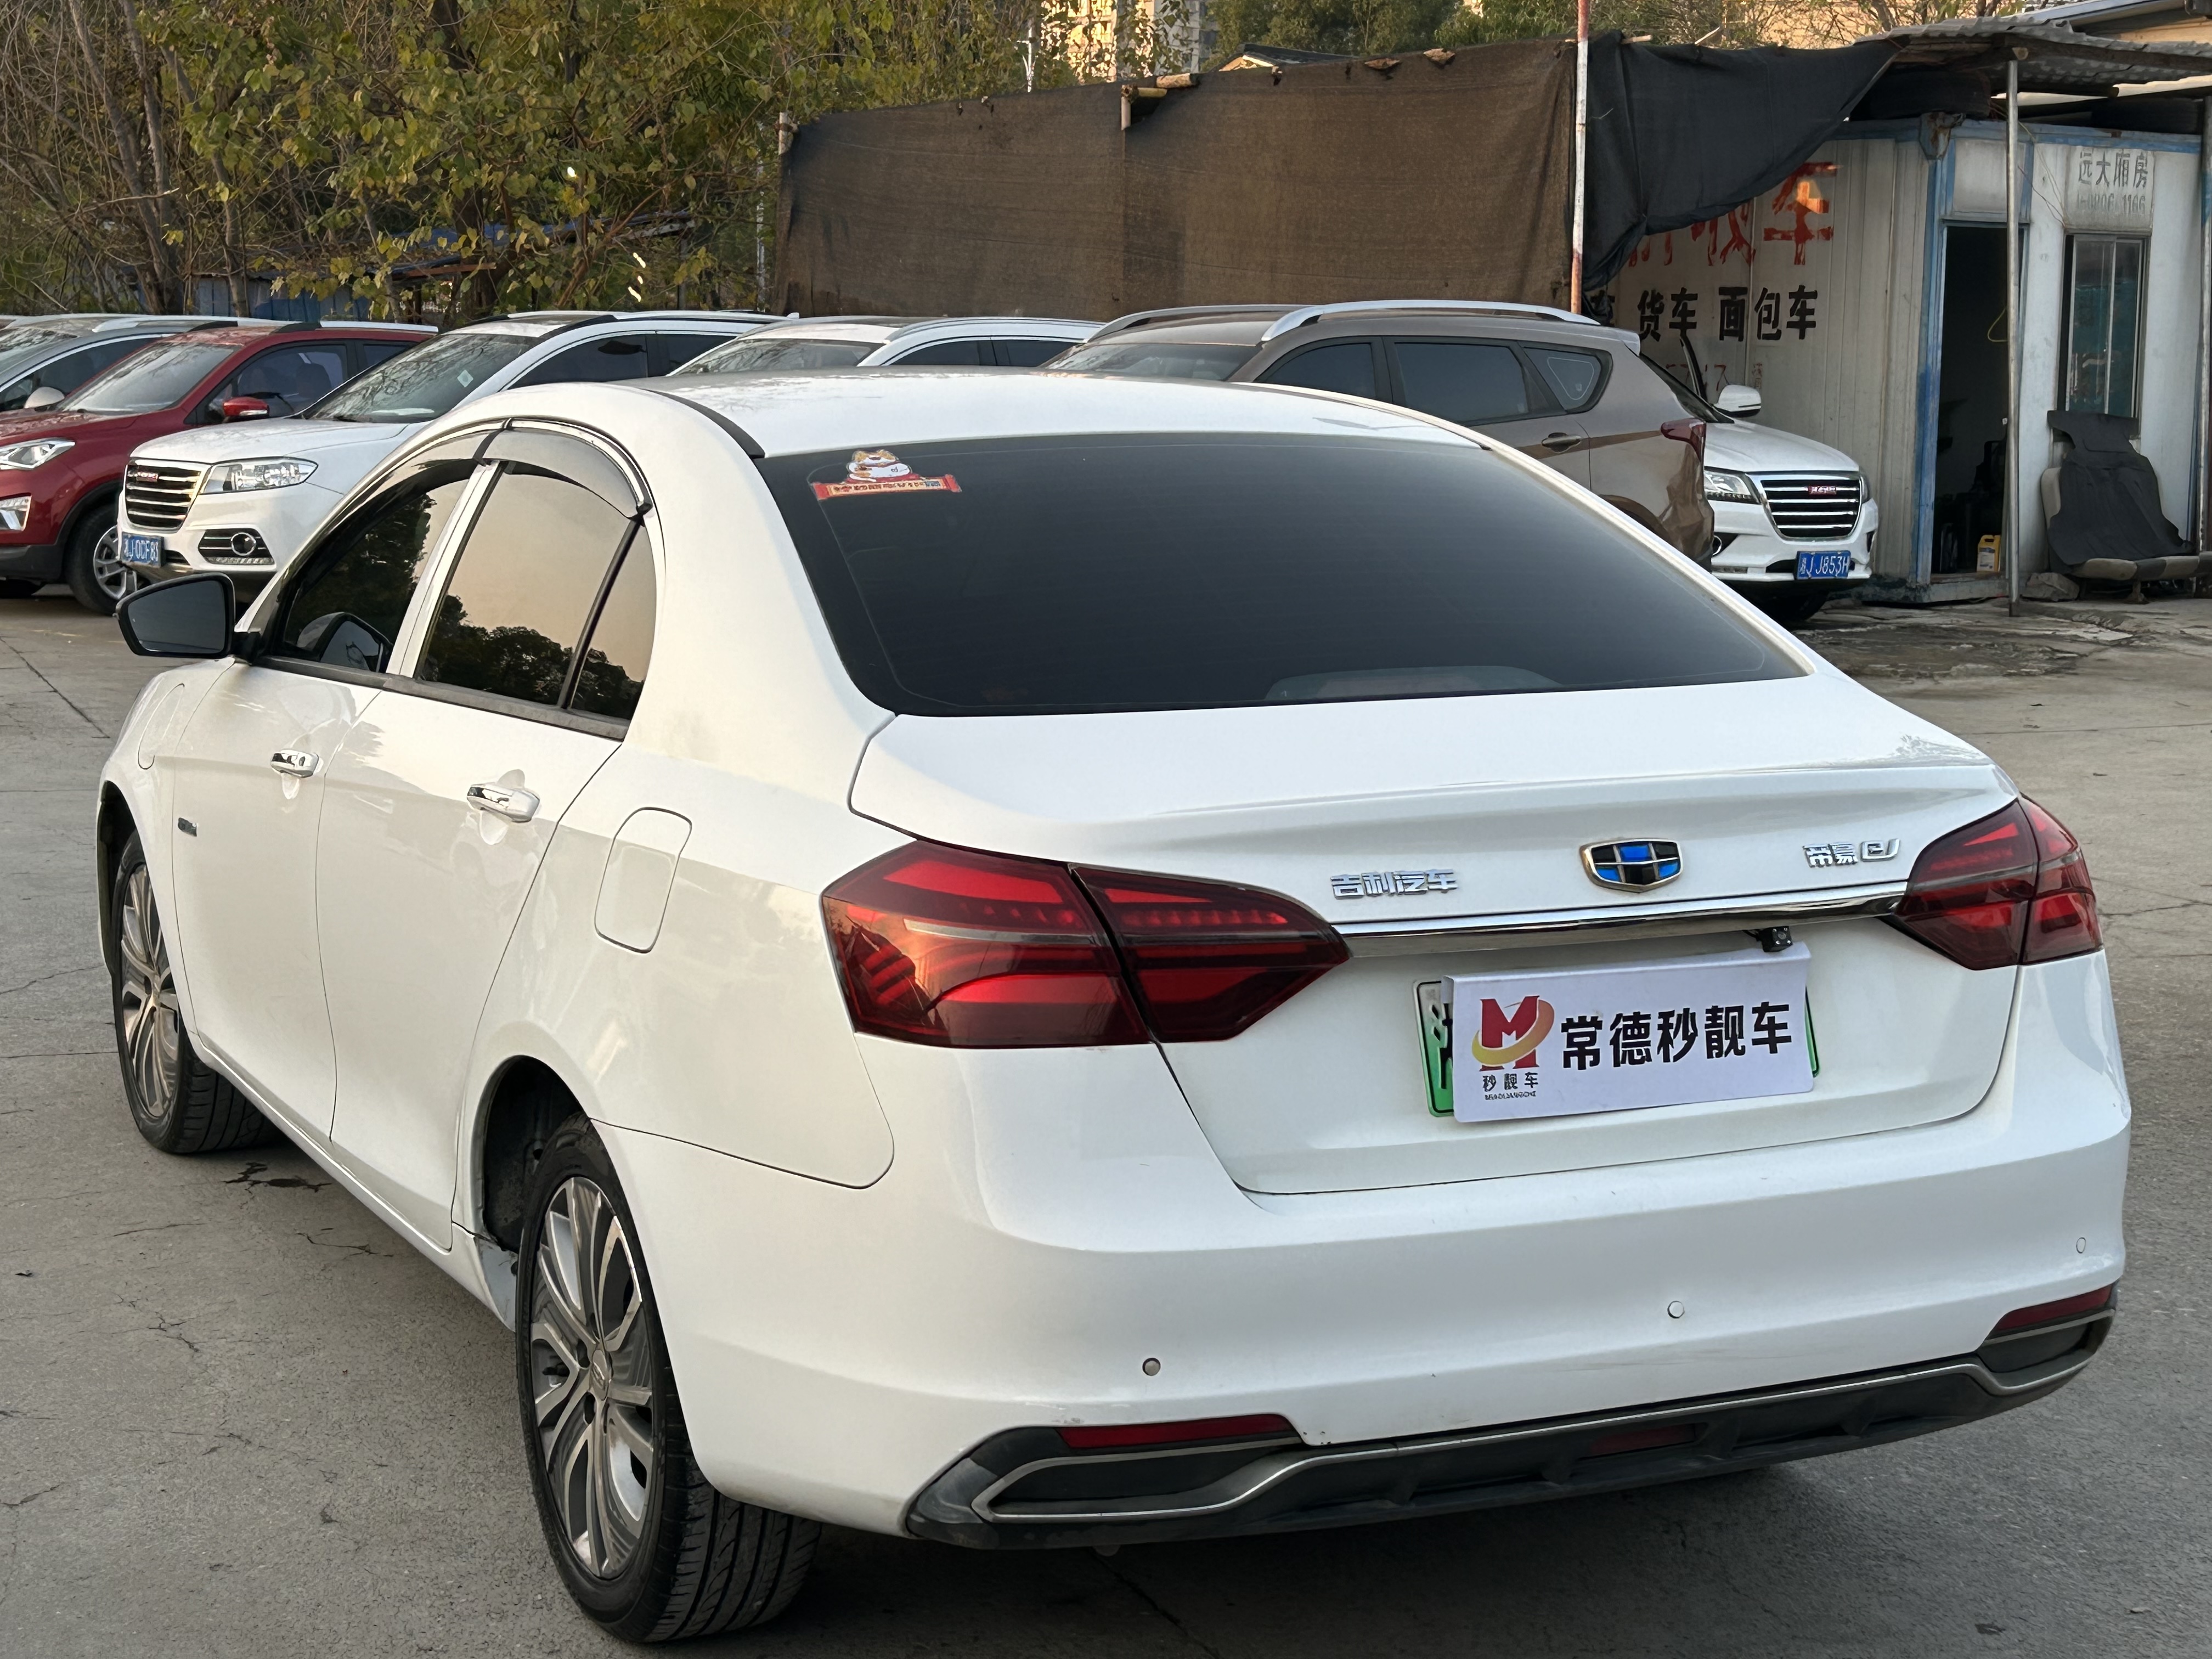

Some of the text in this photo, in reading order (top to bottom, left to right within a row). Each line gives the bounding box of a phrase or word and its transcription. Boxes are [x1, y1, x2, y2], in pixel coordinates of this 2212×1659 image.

[1637, 287, 1699, 342] 货车
[1718, 284, 1819, 342] 面包车
[1560, 1001, 1792, 1071] 常德秒靓车
[1482, 1071, 1539, 1092] 秒靓车
